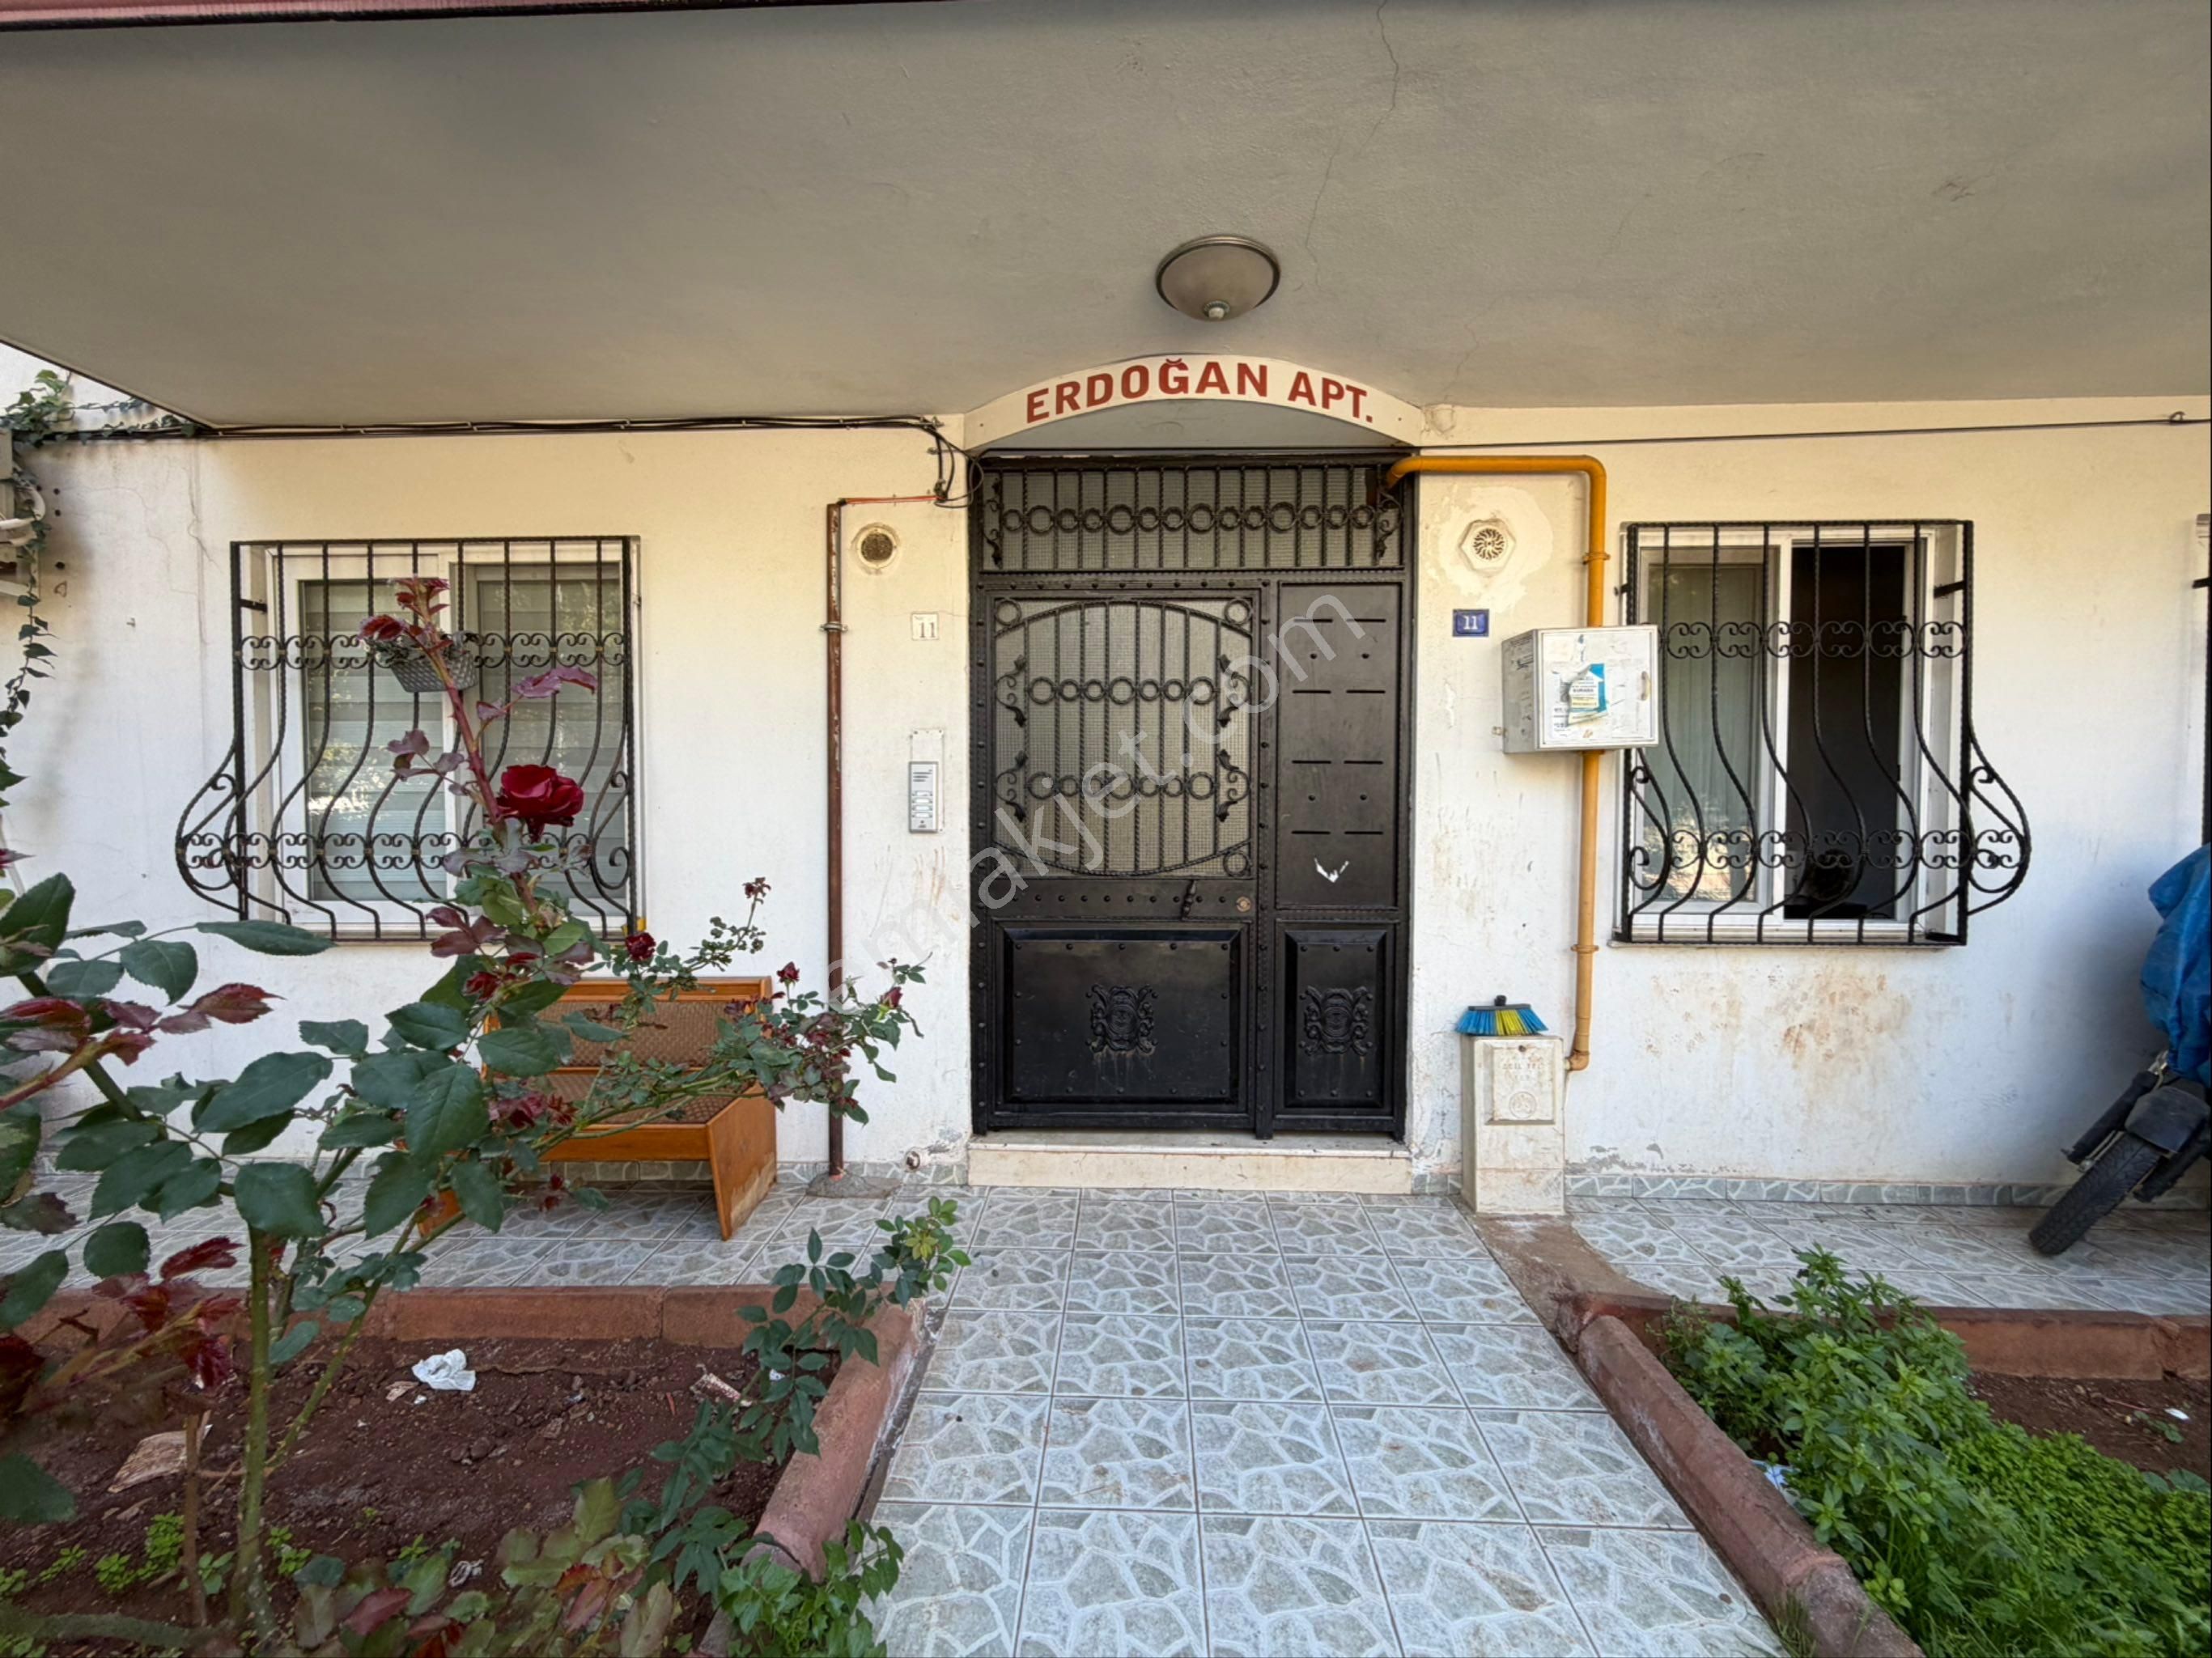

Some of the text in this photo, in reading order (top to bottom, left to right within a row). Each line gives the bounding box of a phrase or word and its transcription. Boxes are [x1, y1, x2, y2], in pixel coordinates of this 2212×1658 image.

[1027, 358, 1373, 424] ERDOĞAN APT.
[919, 621, 936, 638] 11
[1463, 615, 1478, 630] 11
